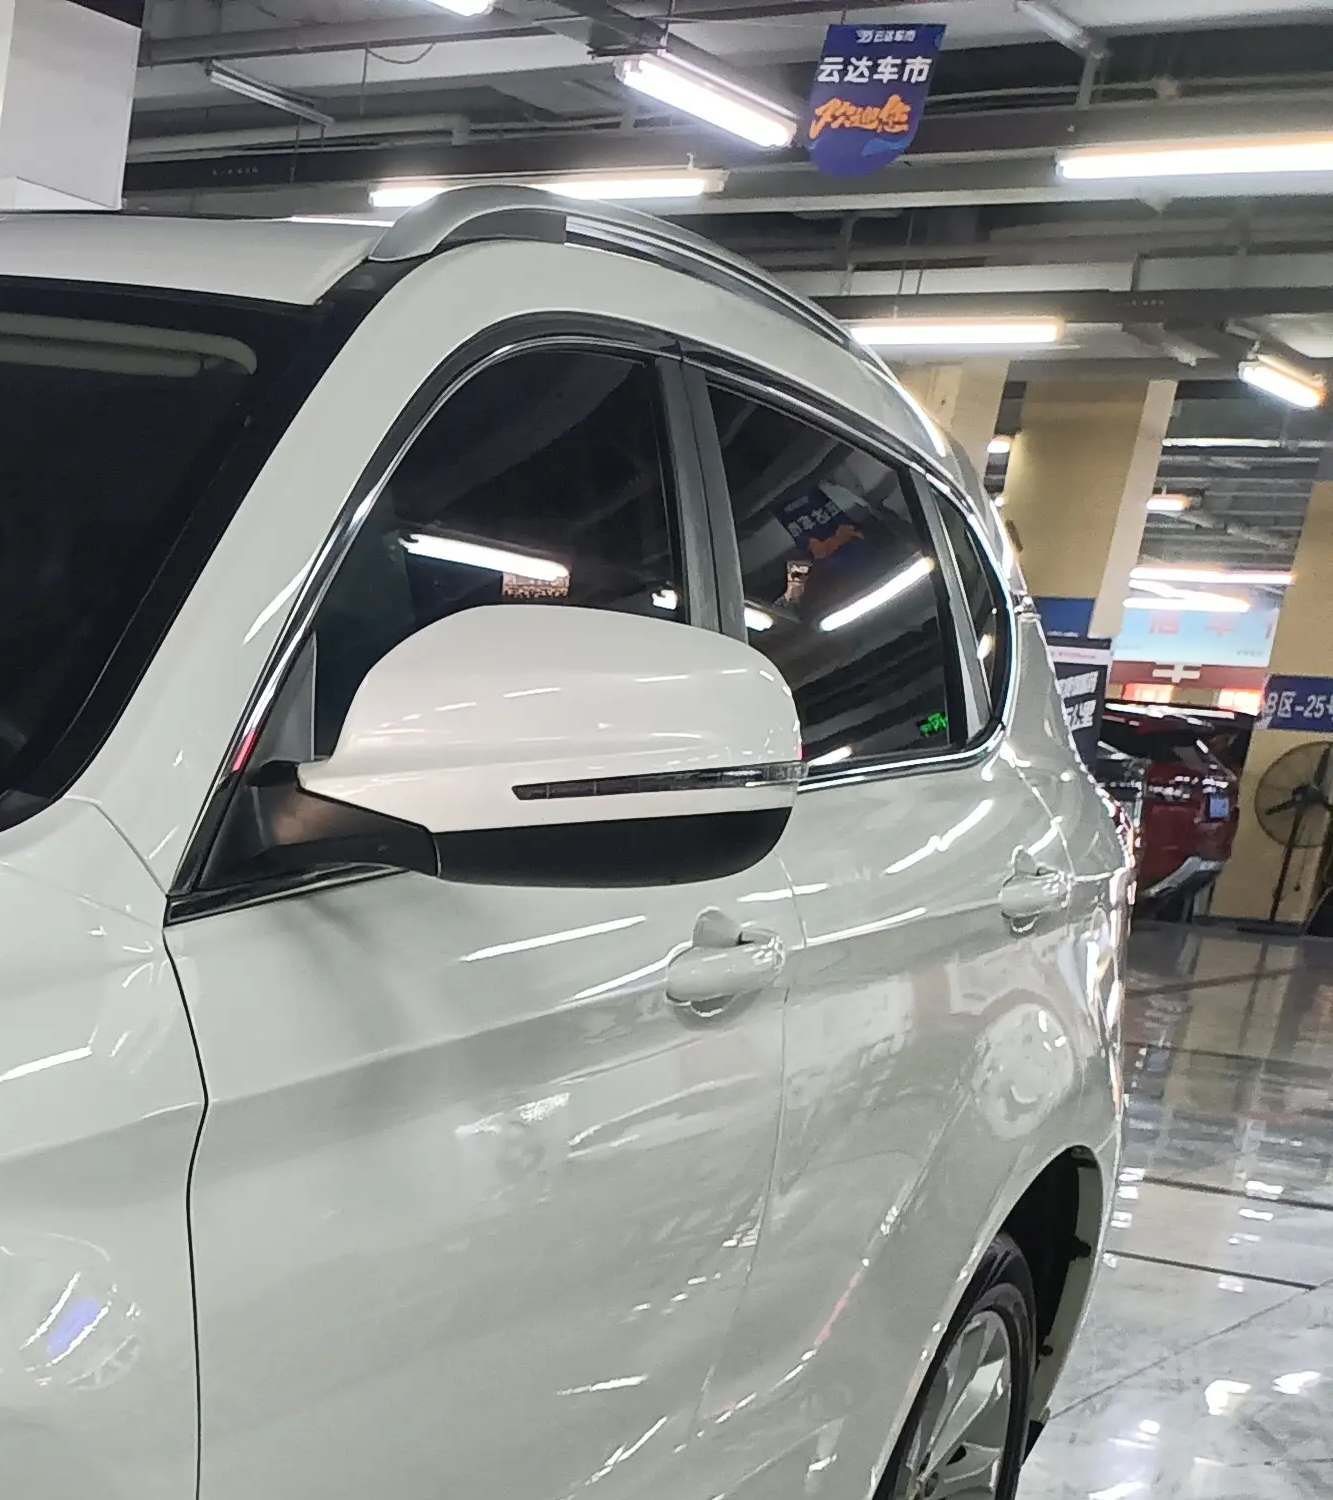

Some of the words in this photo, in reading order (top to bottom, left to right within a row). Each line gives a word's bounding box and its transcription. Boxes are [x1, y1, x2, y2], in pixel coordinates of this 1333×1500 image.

[817, 55, 932, 84] 云达车市
[809, 94, 911, 139] 欢迎您
